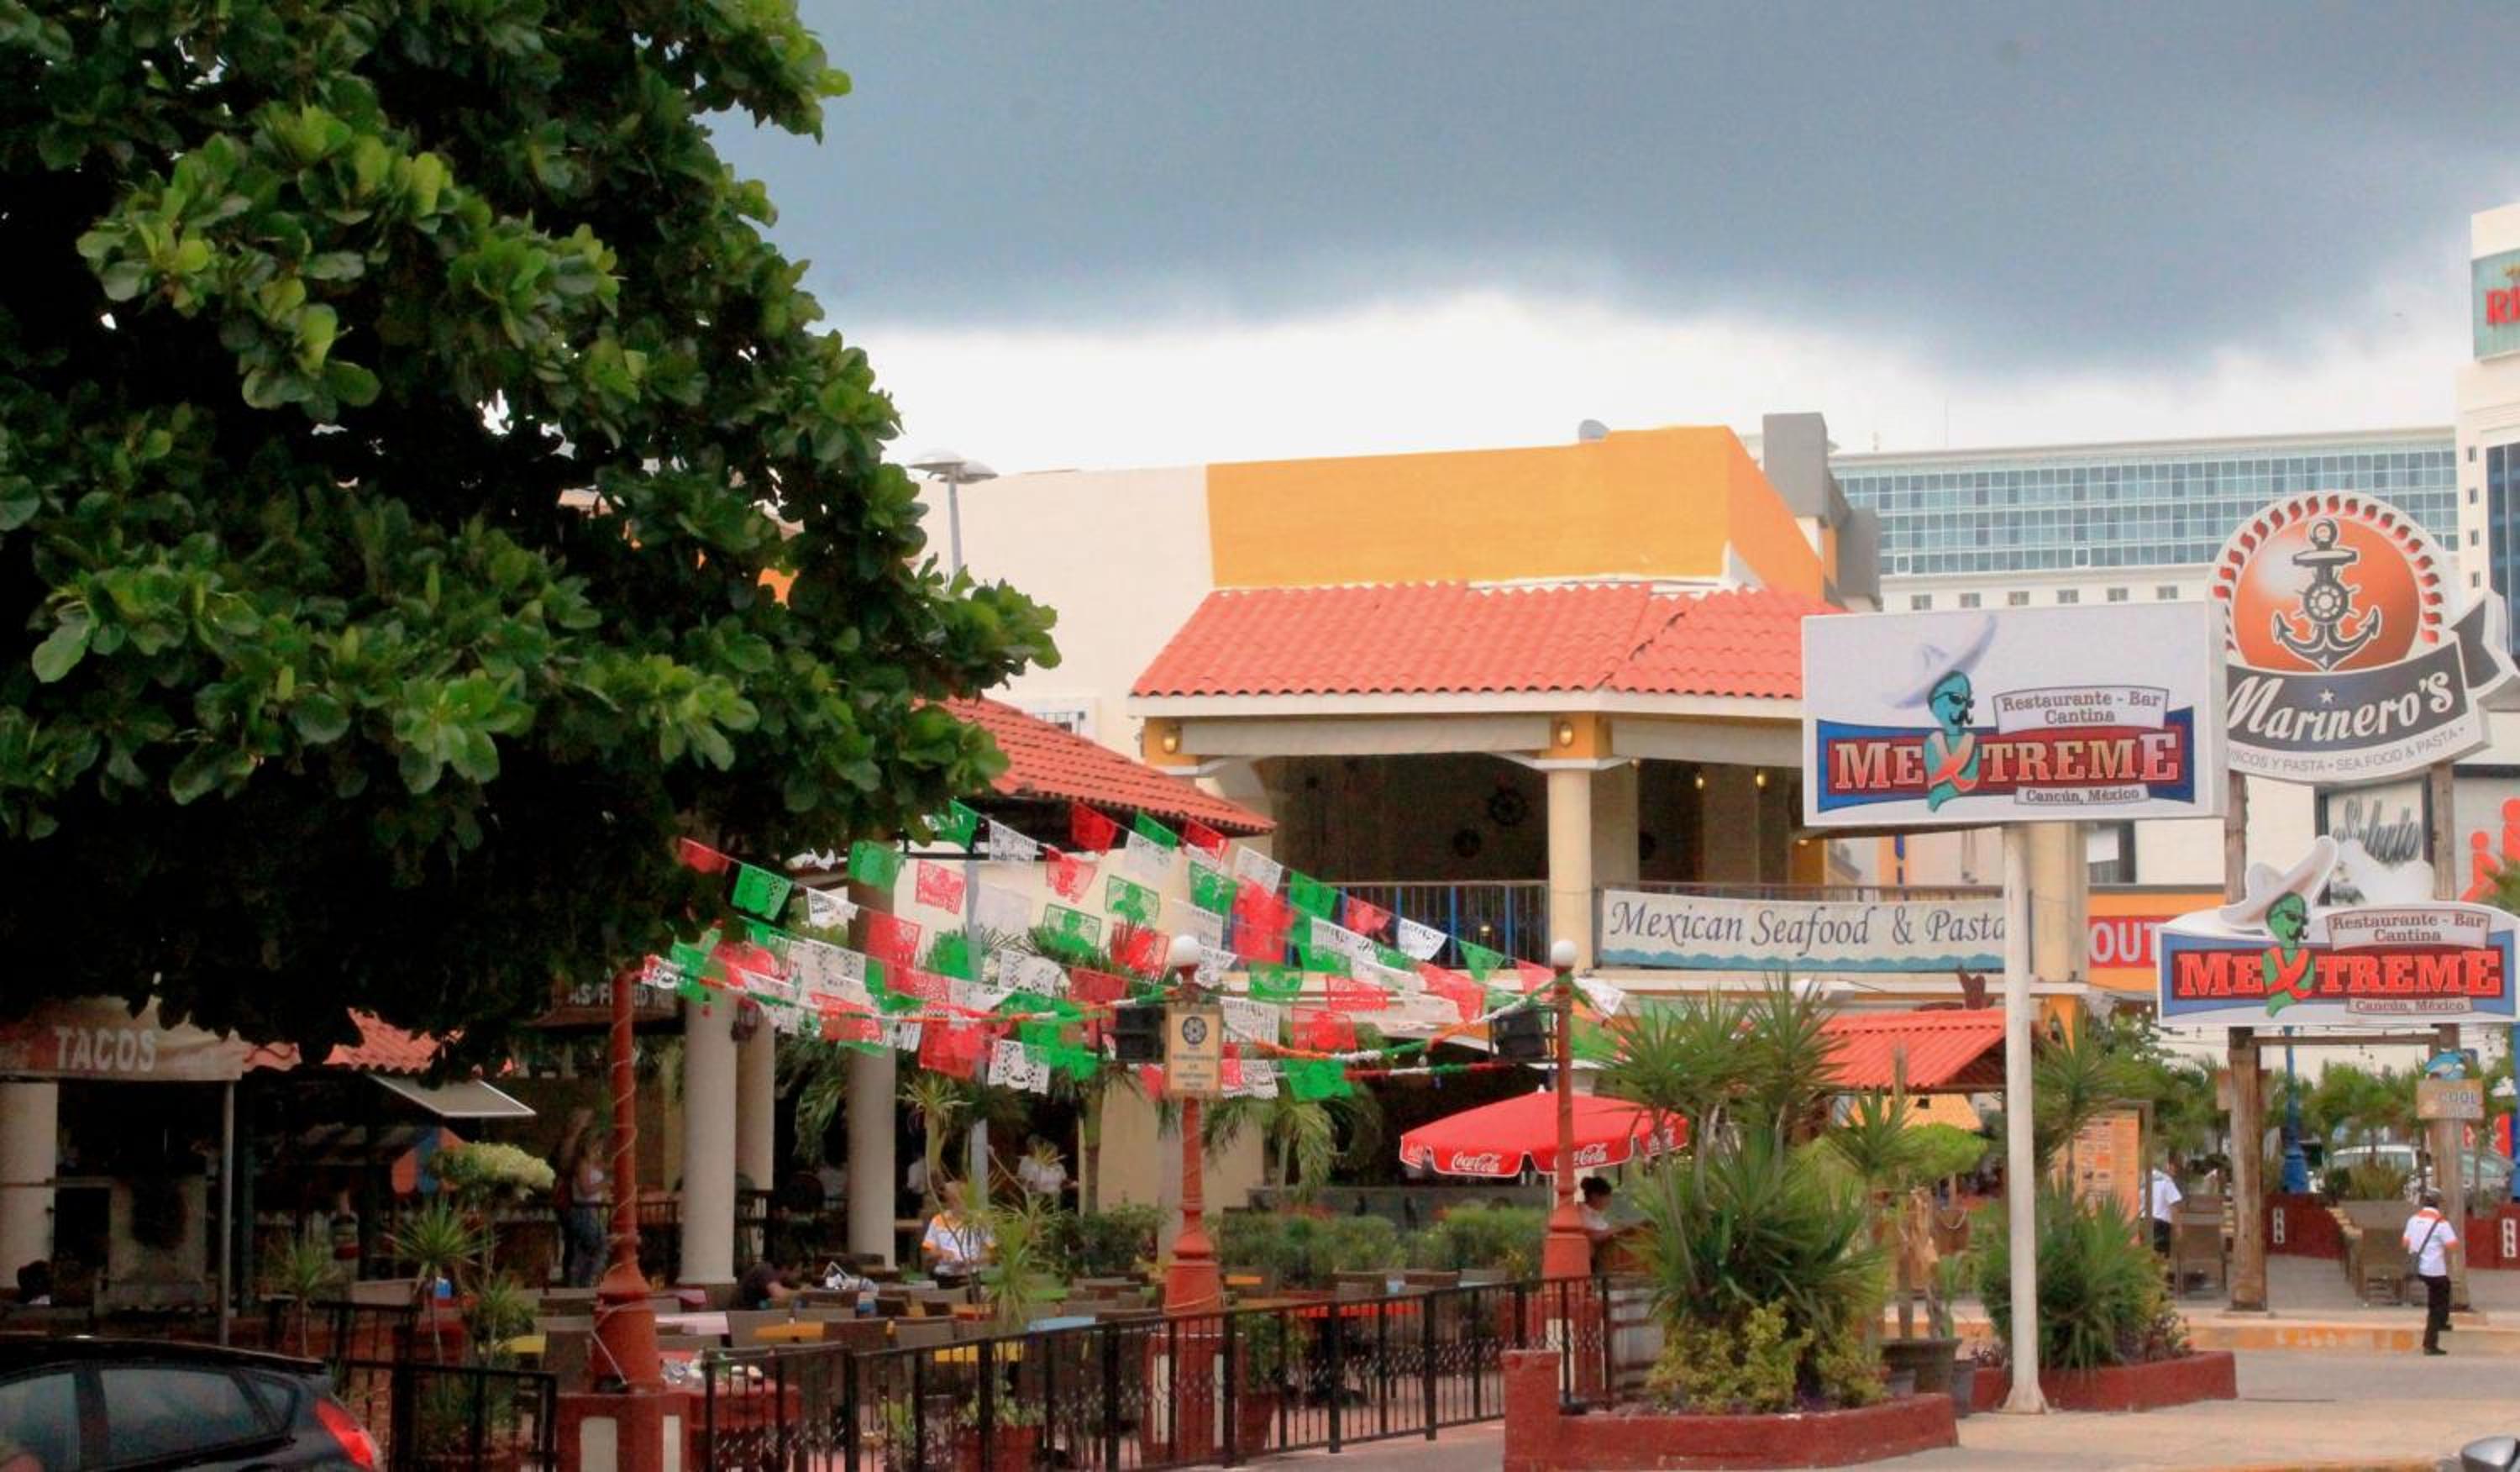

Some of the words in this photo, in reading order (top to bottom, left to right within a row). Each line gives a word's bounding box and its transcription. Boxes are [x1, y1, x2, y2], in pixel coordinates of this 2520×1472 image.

[2002, 691, 2113, 712] Restaurante
[2129, 691, 2161, 707] Bar
[2045, 708, 2115, 725] Cantina
[2416, 728, 2458, 753] PASTA
[2026, 789, 2083, 804] Cancún,
[2088, 786, 2139, 802] México
[1609, 901, 1741, 948] Mexican
[1751, 906, 1877, 956] Seafood
[1892, 907, 1914, 944] &
[2333, 912, 2437, 930] Restaurante
[2454, 912, 2485, 928] Bar
[2374, 928, 2441, 942] Cantina
[2415, 998, 2465, 1011] México
[55, 1025, 158, 1072] TACOS
